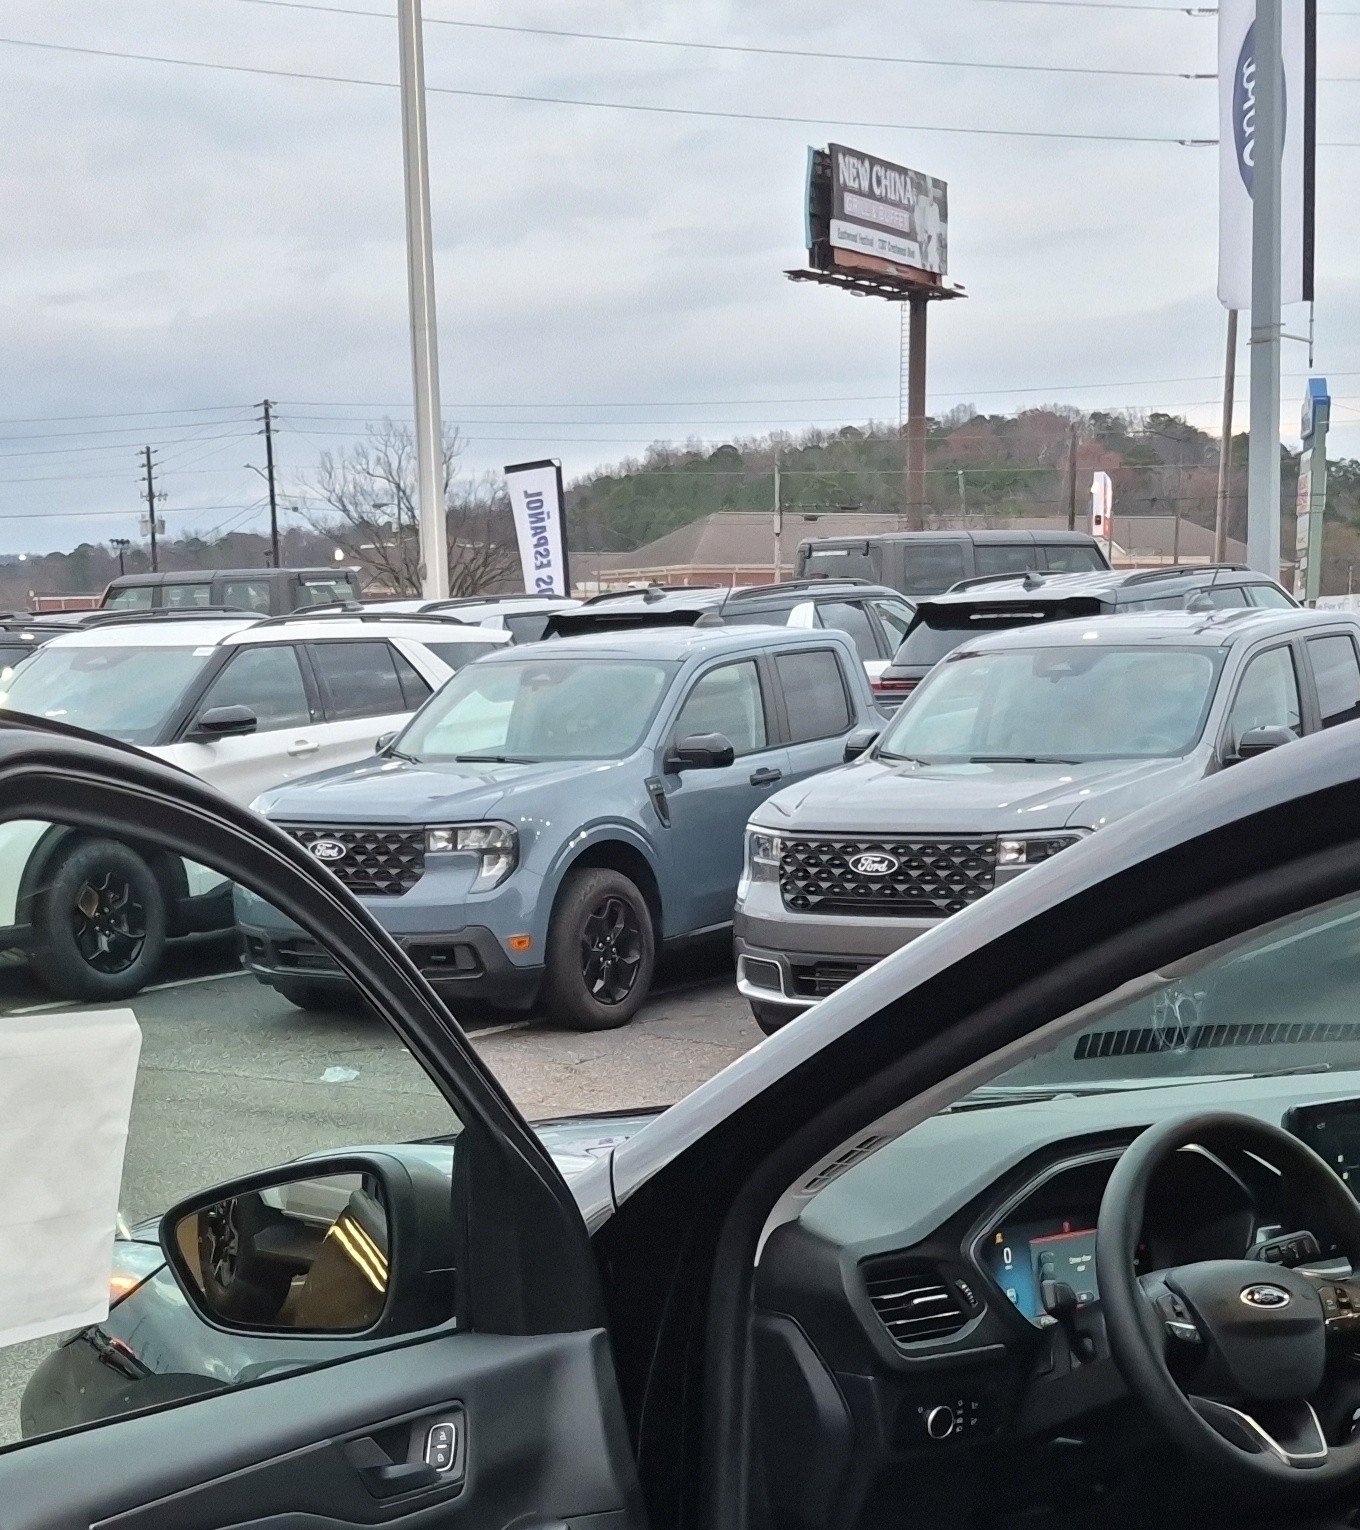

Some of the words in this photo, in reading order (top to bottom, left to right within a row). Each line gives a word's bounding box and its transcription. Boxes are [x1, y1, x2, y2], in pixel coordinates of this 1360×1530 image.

[838, 153, 870, 193] NEW
[872, 164, 913, 206] CHINA
[314, 842, 340, 857] Ford
[857, 856, 890, 872] Ford
[1002, 1246, 1013, 1264] 0
